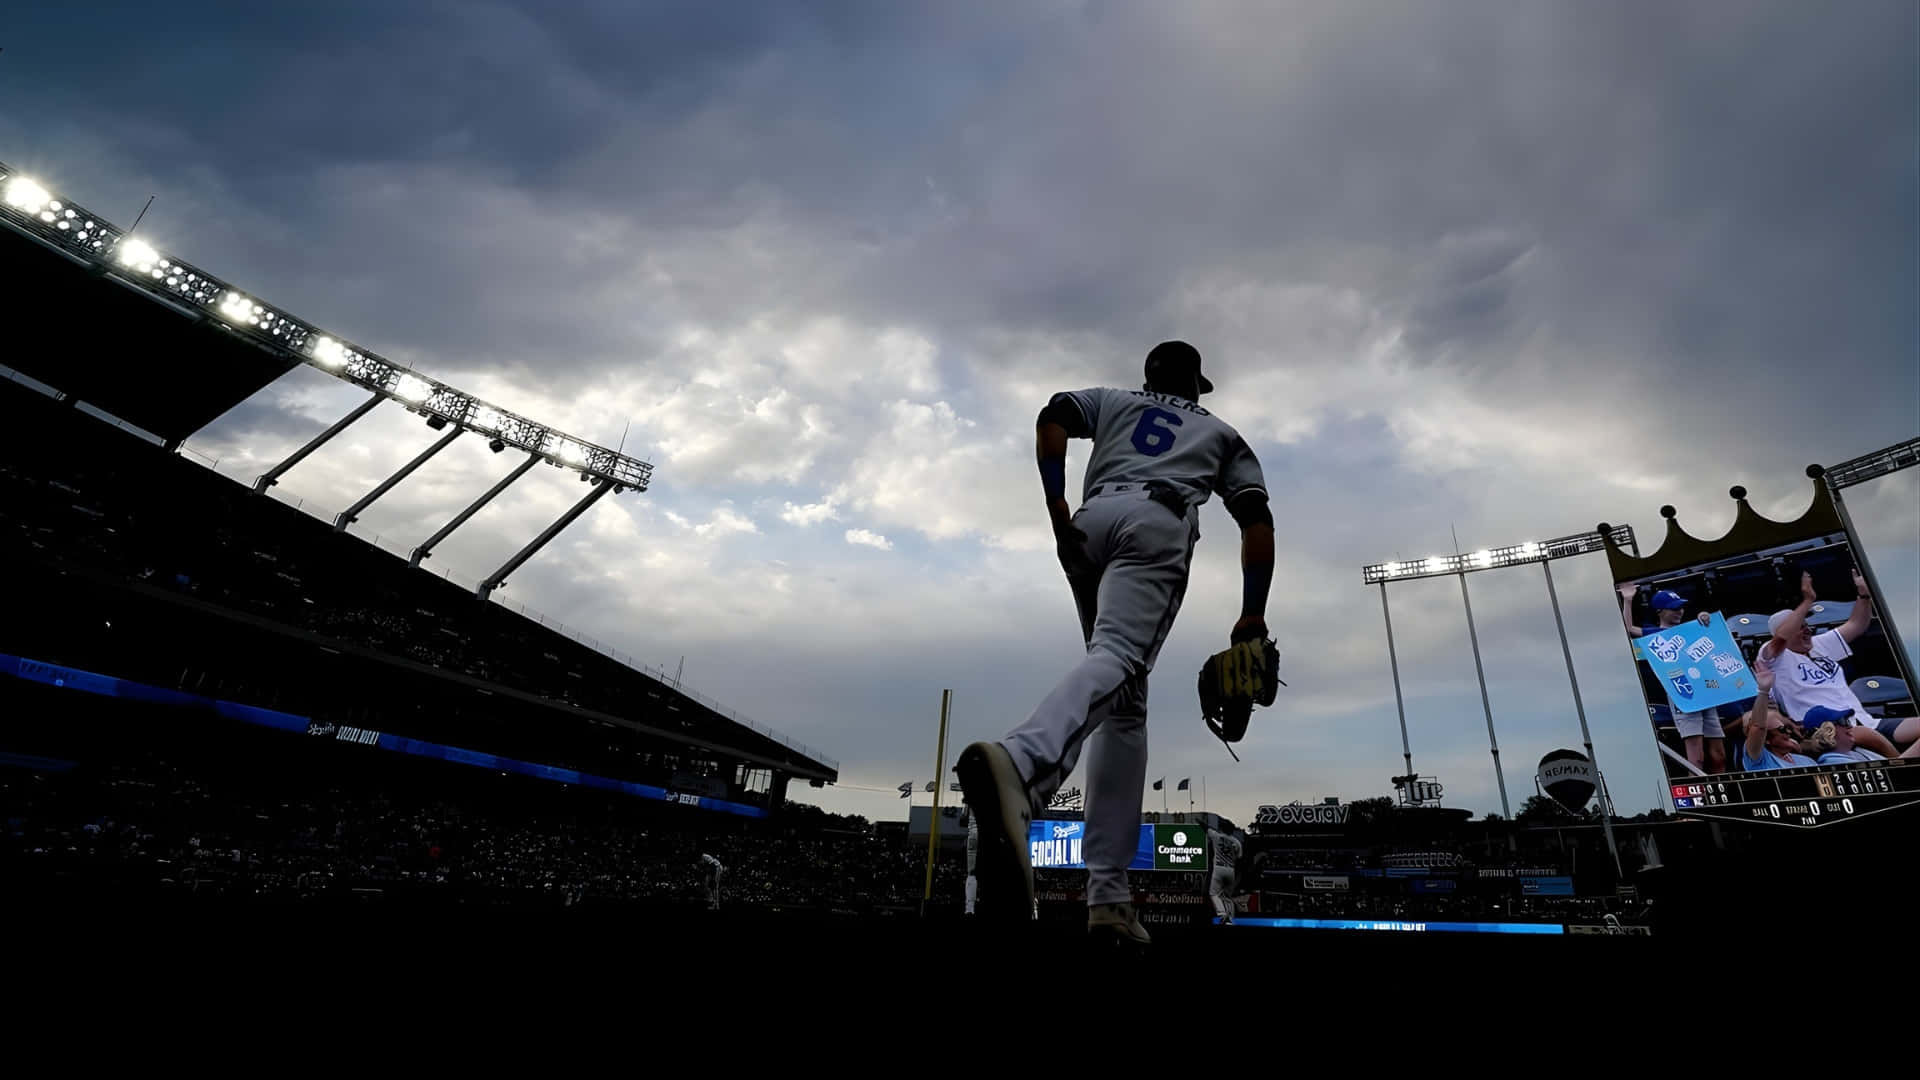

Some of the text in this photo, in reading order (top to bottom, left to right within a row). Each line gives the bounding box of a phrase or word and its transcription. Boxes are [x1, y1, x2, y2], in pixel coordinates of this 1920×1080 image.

[1130, 407, 1183, 457] 6
[1544, 765, 1590, 778] RE/MAX
[1279, 805, 1350, 823] evergy
[1769, 804, 1780, 818] 0
[1809, 801, 1820, 816] 0
[1842, 799, 1854, 814] 0
[1031, 840, 1069, 867] SOCIAL
[1158, 845, 1203, 855] Commerce
[1169, 854, 1192, 863] Bank
